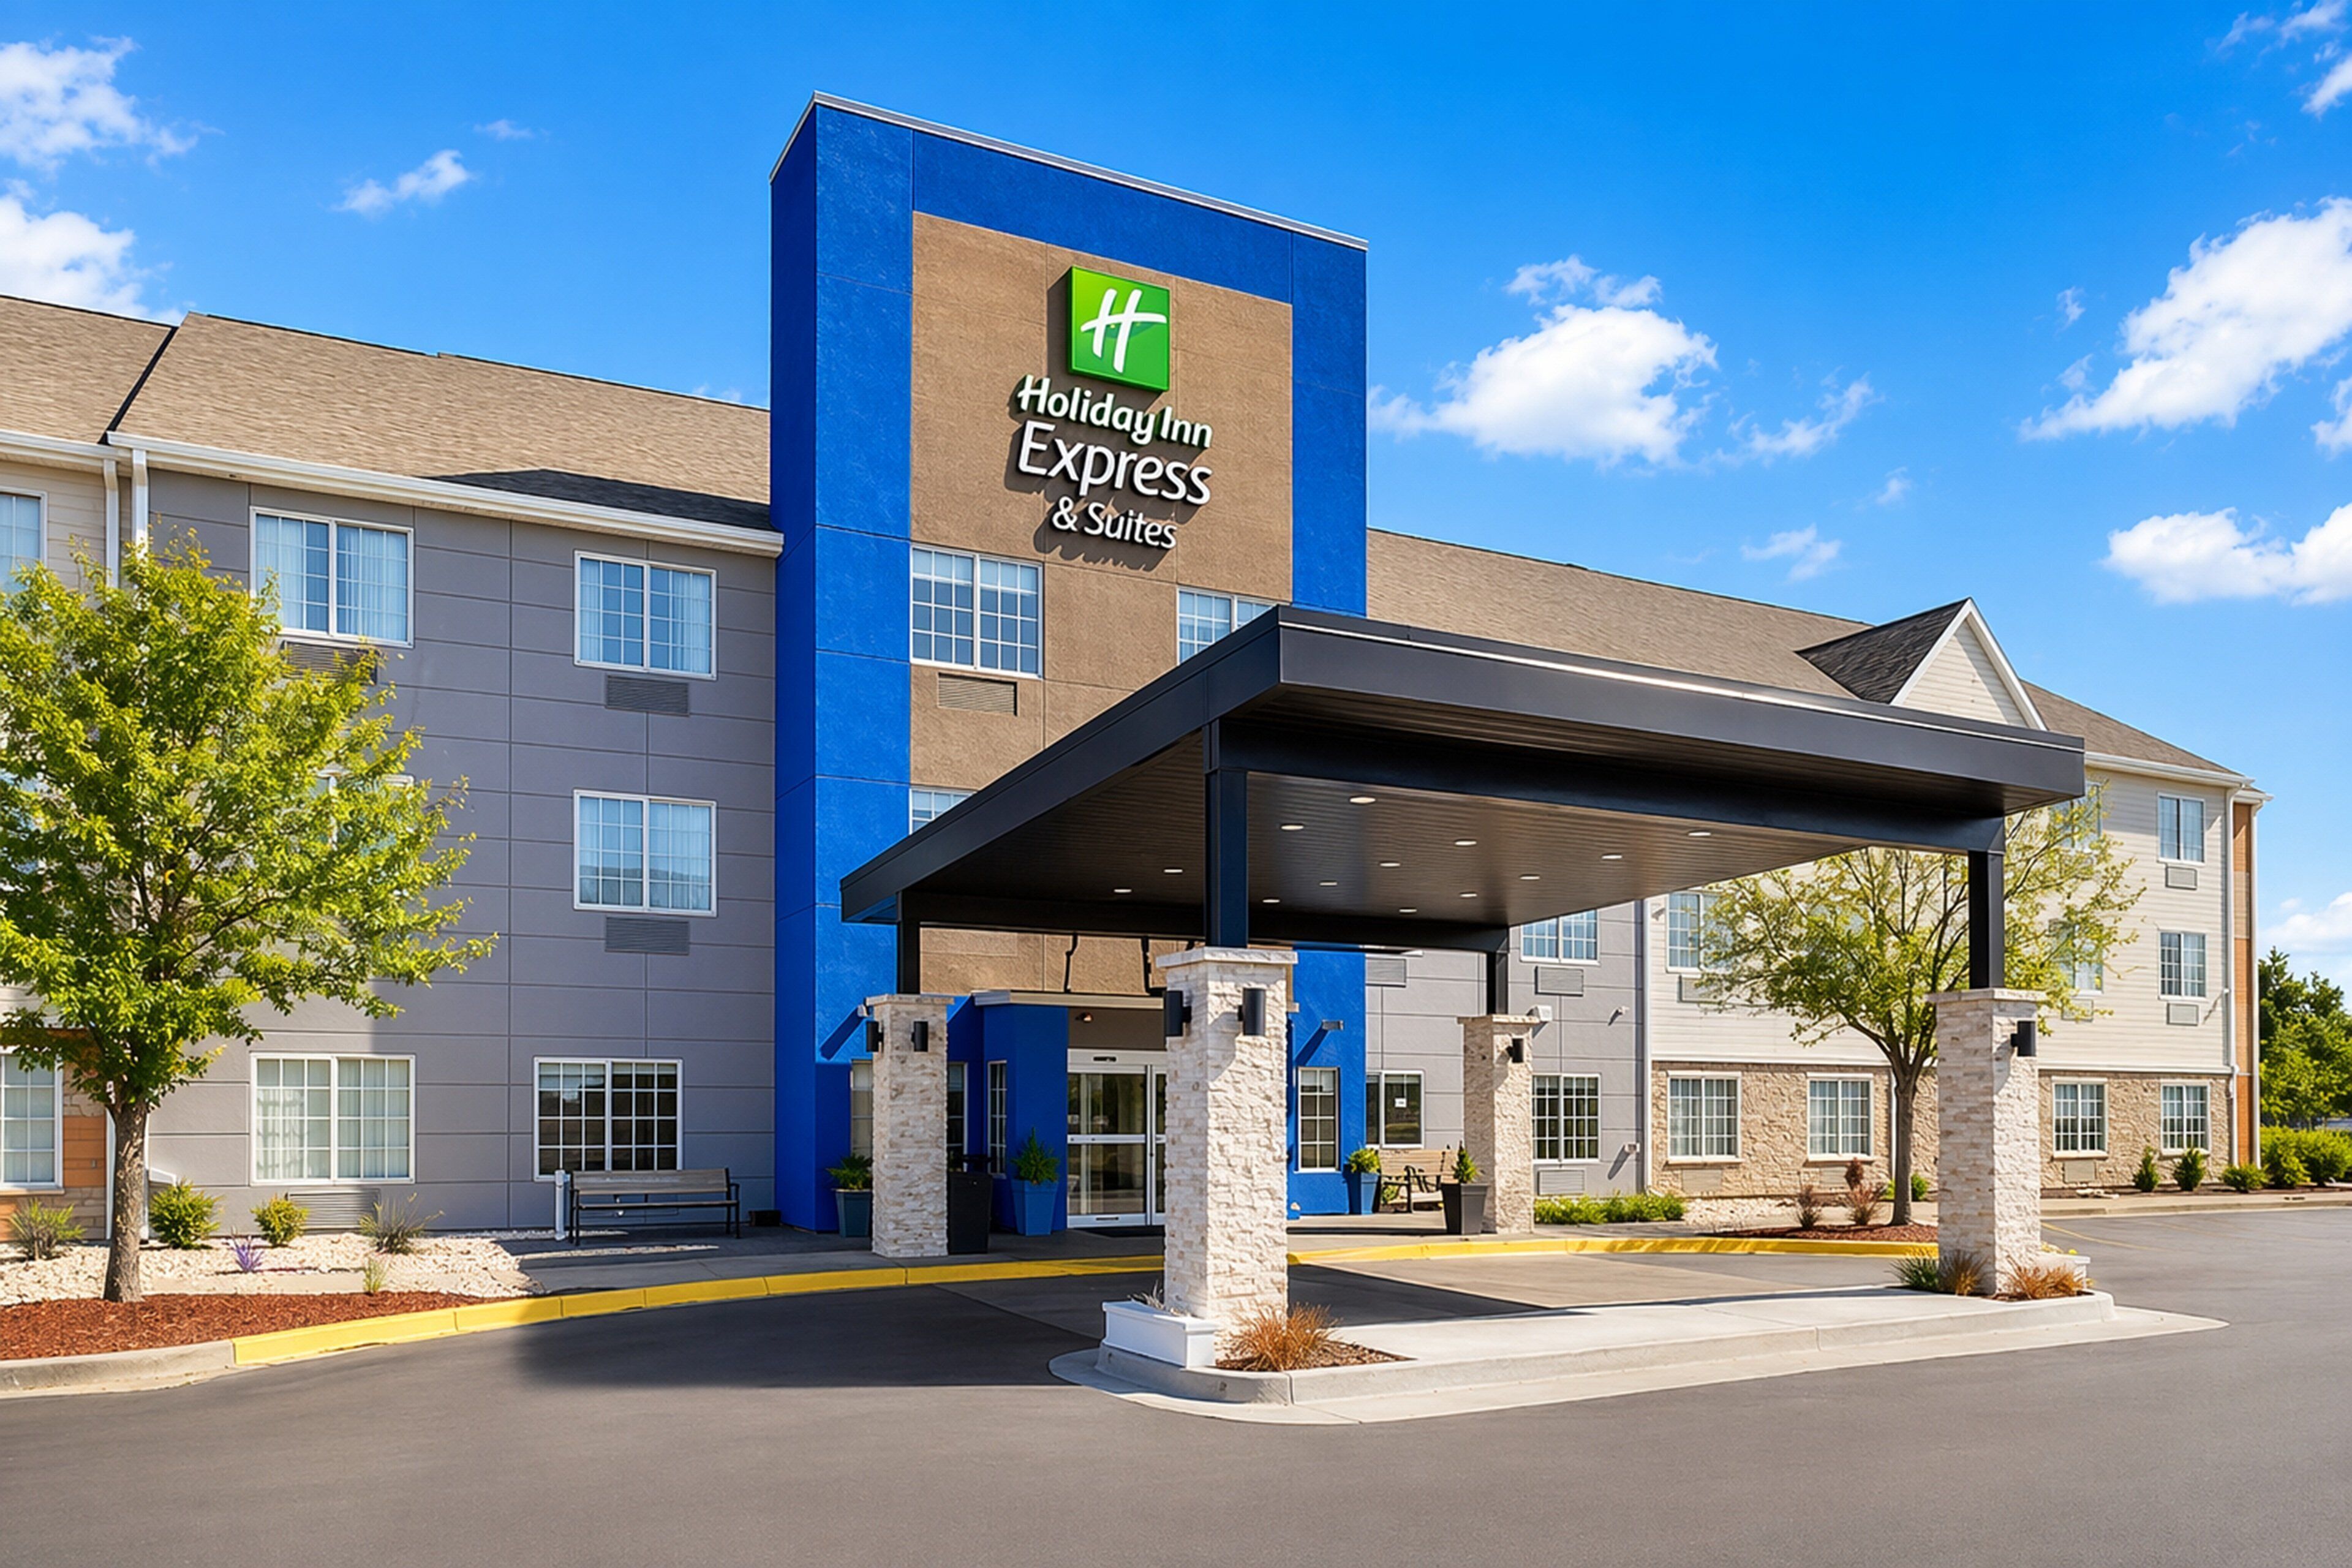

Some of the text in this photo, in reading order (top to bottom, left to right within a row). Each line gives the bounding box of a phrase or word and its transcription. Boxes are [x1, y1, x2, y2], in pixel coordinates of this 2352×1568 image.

[1080, 288, 1167, 373] H
[1017, 374, 1213, 448] Holiday Inn
[1018, 420, 1213, 505] Express
[1052, 496, 1177, 549] & Suites
